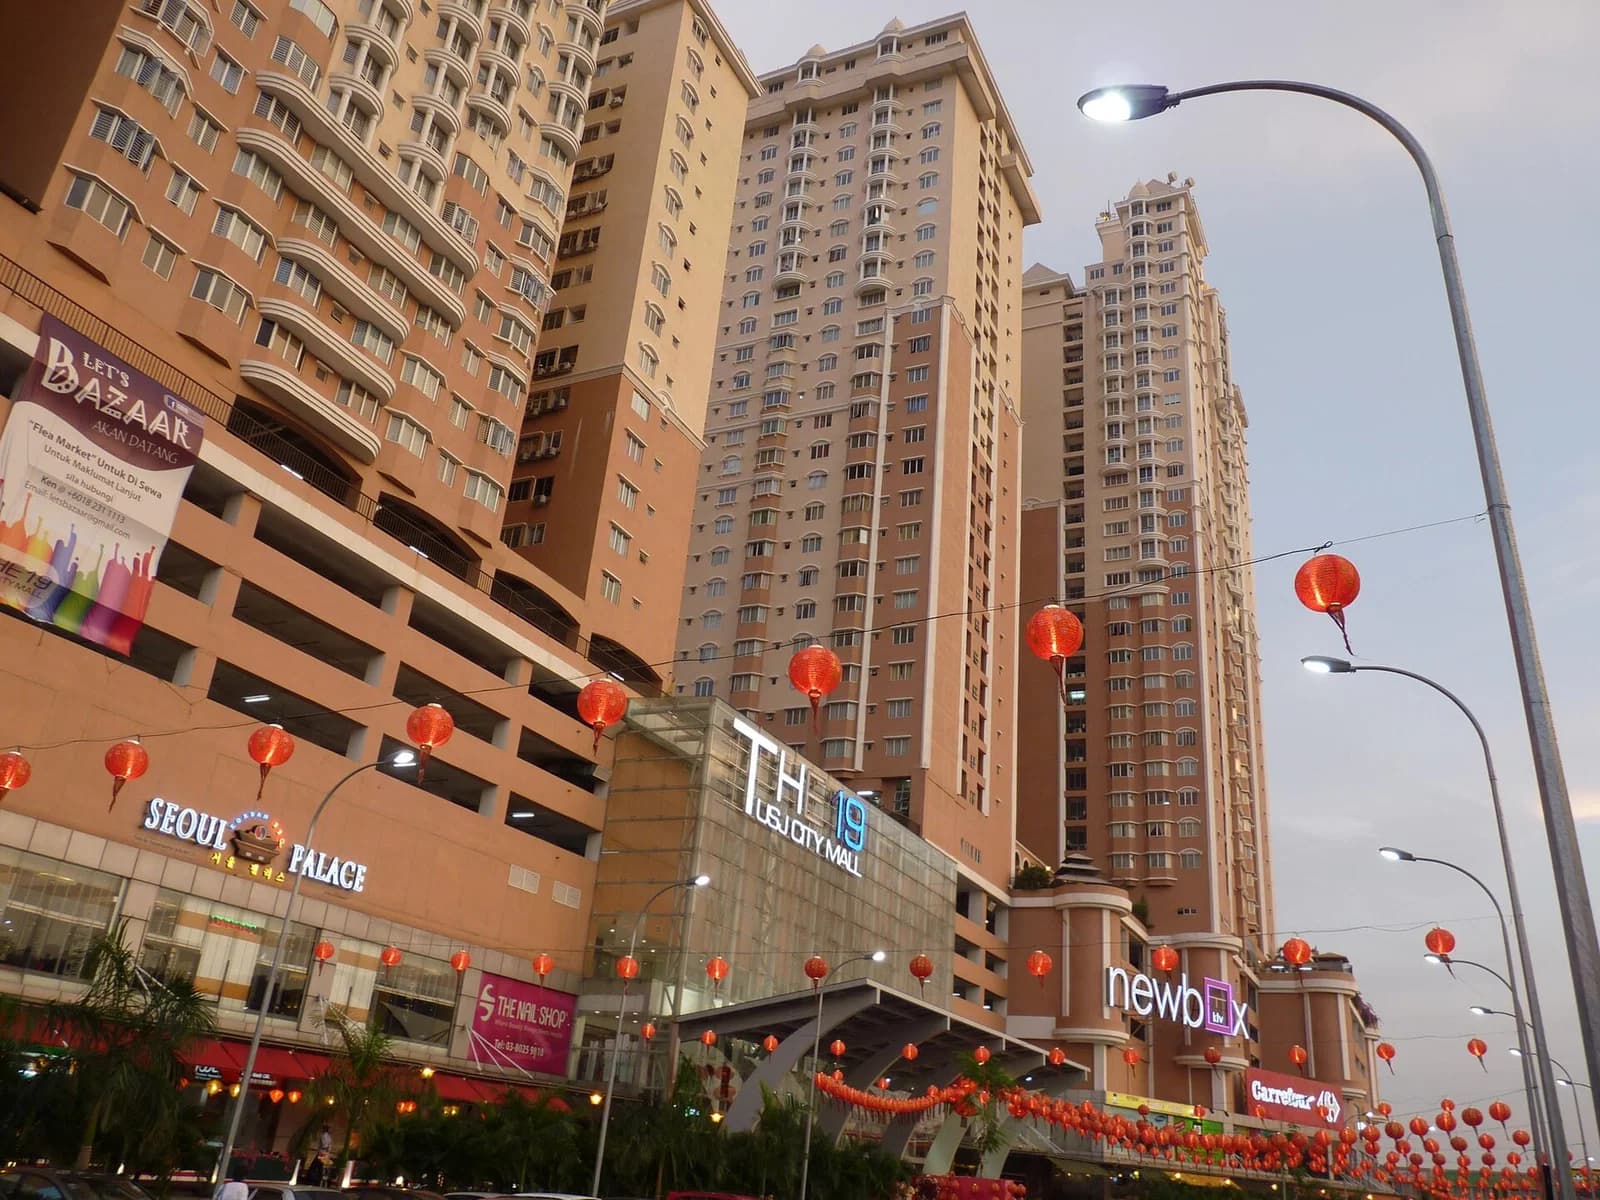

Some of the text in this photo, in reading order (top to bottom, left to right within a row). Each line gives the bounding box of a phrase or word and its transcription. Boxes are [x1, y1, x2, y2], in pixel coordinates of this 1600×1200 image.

[82, 351, 130, 388] LET'S
[41, 336, 192, 449] BAZAAR
[92, 420, 178, 464] AKAN DATANG
[40, 475, 57, 489] Ken
[43, 444, 142, 503] Untuk Maklumat Lanjut
[80, 479, 114, 503] hubungi
[97, 458, 127, 480] Untuk
[127, 473, 139, 487] Di
[138, 479, 163, 499] Sewa
[733, 717, 867, 852] THE 19
[144, 797, 228, 850] SEOUL
[756, 798, 863, 878] USJ CITY MALL
[288, 843, 368, 892] PALACE
[498, 995, 566, 1028] THE NAIL SHOP
[1251, 1079, 1315, 1110] Carrefour
